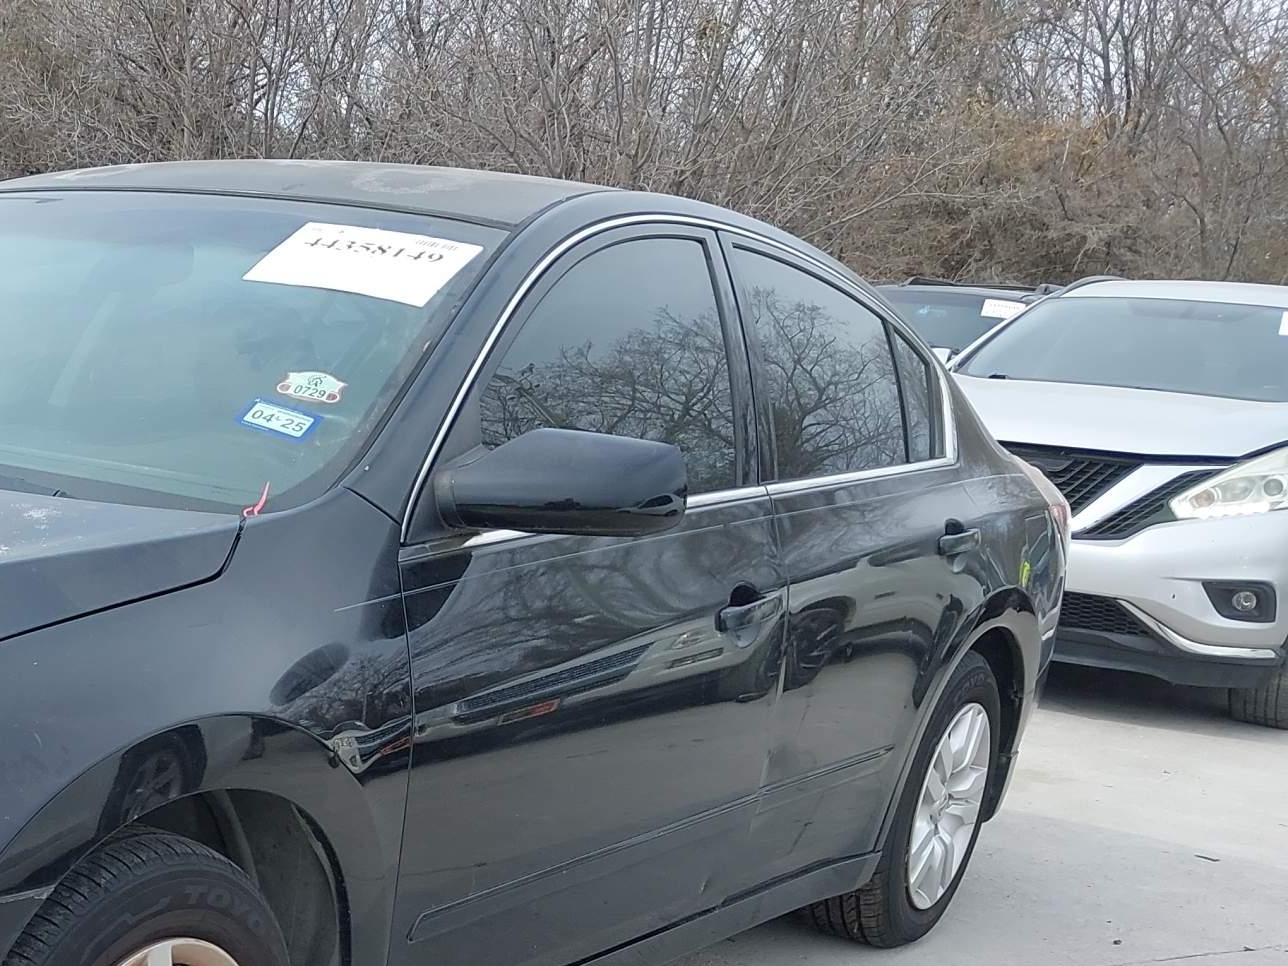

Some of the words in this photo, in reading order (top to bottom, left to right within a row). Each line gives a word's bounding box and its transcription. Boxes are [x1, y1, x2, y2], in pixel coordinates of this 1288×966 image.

[304, 237, 445, 263] 44358149
[293, 384, 327, 399] 0729
[251, 409, 275, 423] 04
[280, 418, 306, 433] 25
